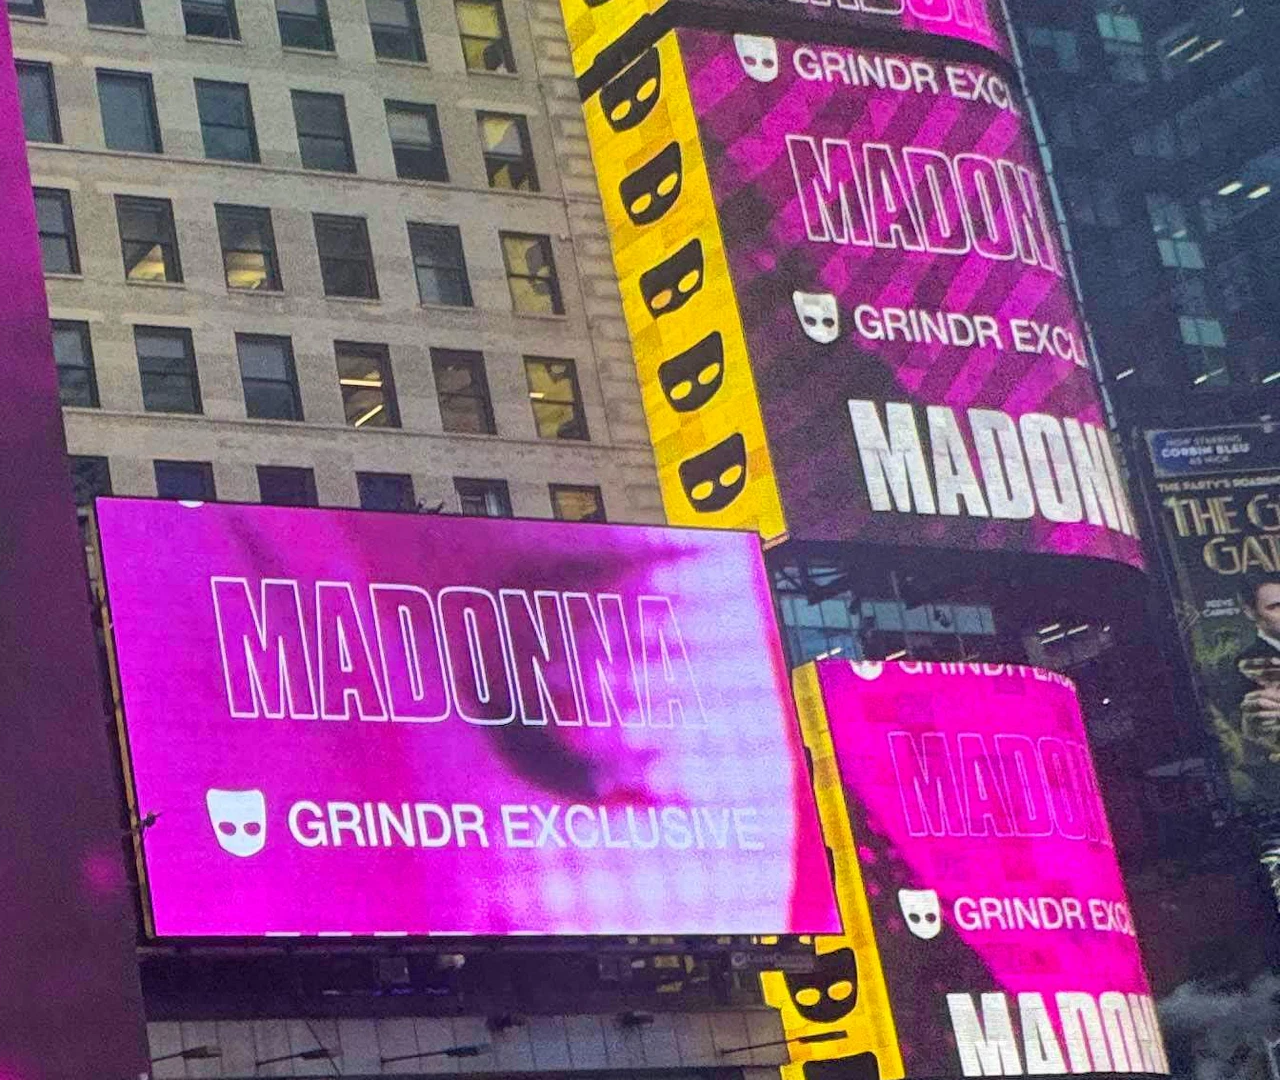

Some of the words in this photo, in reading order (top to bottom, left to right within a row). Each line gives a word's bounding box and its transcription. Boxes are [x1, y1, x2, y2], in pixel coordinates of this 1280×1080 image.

[792, 48, 938, 94] GRINDR
[854, 304, 1004, 350] GRINDR
[1164, 495, 1240, 537] THE
[210, 576, 707, 728] MADONNA
[288, 801, 488, 848] GRINDR
[502, 804, 765, 852] EXCLUSIVE
[954, 897, 1086, 932] GRINDR
